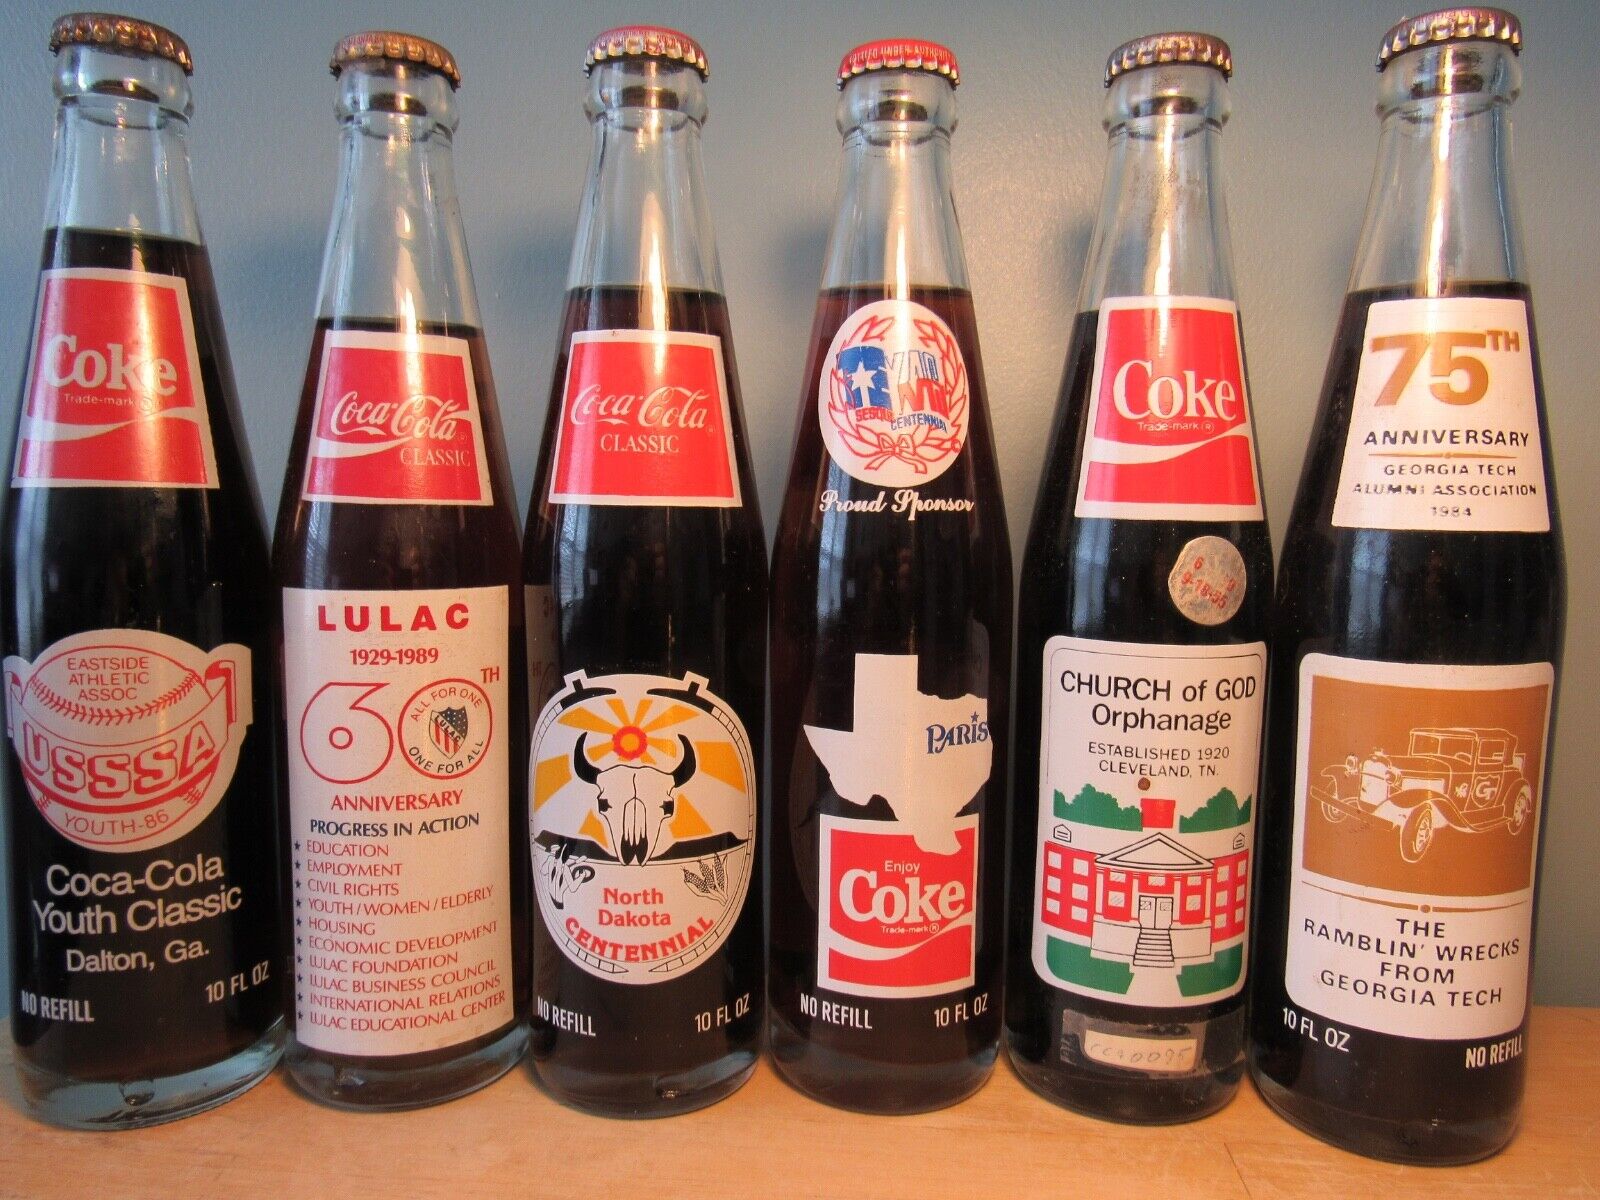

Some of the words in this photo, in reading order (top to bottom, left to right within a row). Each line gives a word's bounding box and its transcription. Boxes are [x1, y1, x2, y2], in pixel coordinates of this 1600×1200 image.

[43, 334, 178, 396] Coke
[570, 384, 709, 429] Coca-Cola
[1112, 360, 1237, 421] Coke
[331, 391, 460, 440] Coca-Cola
[600, 433, 680, 453] CLASSIC
[1364, 429, 1529, 447] ANNIVERSARY
[401, 448, 470, 466] CLASSIC
[1384, 464, 1469, 475] GEORGIA
[1478, 464, 1516, 476] TECH
[819, 489, 887, 513] Proud
[891, 489, 975, 521] Sponsor
[1353, 483, 1425, 495] ALUMNI
[1433, 484, 1537, 496] ASSOCIATION
[1430, 506, 1472, 517] 1984
[318, 603, 469, 632] LULAC
[67, 656, 150, 671] EASTSIDE
[350, 648, 439, 665] 1929-1989
[69, 672, 150, 686] ATHLETIC
[78, 687, 138, 701] ASSOC
[1060, 670, 1171, 701] CHURCH
[1182, 679, 1208, 701] of
[1215, 676, 1256, 701] GOD
[411, 700, 430, 722] ALL
[431, 687, 457, 701] FOR
[460, 688, 482, 708] ONE
[1092, 703, 1231, 735] Orphanage
[434, 715, 461, 743] LULAC
[926, 716, 990, 755] PARIS
[23, 720, 215, 799] USSSA
[409, 747, 433, 771] ONE
[437, 760, 463, 773] FOR
[467, 740, 483, 763] ALL
[1088, 741, 1190, 760] ESTABLISHED
[1198, 747, 1229, 760] 1920
[1099, 760, 1192, 778] CLEVELAND,
[1199, 765, 1219, 777] TN.
[331, 789, 463, 811] ANNIVERSARY
[65, 809, 169, 836] YOUTH-86
[310, 819, 388, 837] PROGRESS
[394, 823, 413, 835] IN
[418, 812, 479, 834] ACTION
[307, 840, 389, 857] EDUCATION
[46, 854, 224, 896] Coca-Cola
[307, 859, 402, 876] EMPLOYMENT
[884, 860, 920, 873] Enjoy
[308, 879, 339, 895] CIVIL
[344, 883, 400, 896] RIGHTS
[603, 888, 664, 905] North
[839, 868, 966, 924] Coke
[33, 900, 117, 934] Youth
[127, 884, 242, 931] Classic
[598, 909, 671, 927] Dakota
[309, 917, 375, 935] HOUSING
[309, 936, 390, 954] ECONOMIC
[396, 920, 498, 954] DEVELOPMENT
[565, 916, 714, 962] CENTENNIAL
[1304, 918, 1424, 958] RAMBLIN'
[1436, 939, 1519, 962] WRECKS
[1396, 918, 1445, 938] THE
[67, 949, 154, 972] Dalton,
[165, 940, 209, 964] Ga.
[310, 955, 347, 973] LULAC
[352, 952, 458, 974] FOUNDATION
[205, 981, 225, 1003] 10
[230, 973, 248, 996] FL
[252, 961, 270, 986] OZ
[310, 974, 347, 992] LULAC
[352, 977, 426, 993] BUSINESS
[431, 959, 497, 988] COUNCIL
[1320, 970, 1436, 1006] GEORGIA
[1448, 987, 1501, 1007] TECH
[1380, 962, 1454, 984] FROM
[21, 990, 36, 1016] NO
[41, 997, 94, 1022] REFILL
[310, 993, 423, 1013] INTERNATIONAL
[429, 975, 501, 1007] RELATIONS
[310, 1012, 347, 1030] LULAC
[351, 1009, 456, 1032] EDUCATIONAL
[461, 990, 505, 1017] CENTER
[537, 996, 549, 1021] NO
[552, 1004, 596, 1037] REFILL
[695, 1012, 711, 1033] 10
[717, 1002, 731, 1026] FL
[736, 993, 750, 1016] OZ
[800, 993, 817, 1017] NO
[822, 1001, 872, 1029] REFILL
[934, 1007, 949, 1028] 10
[955, 1002, 969, 1023] FL
[974, 993, 988, 1014] OZ
[1283, 1007, 1297, 1030] 10
[1300, 1017, 1318, 1042] FL
[1325, 1027, 1351, 1052] OZ
[1466, 1046, 1486, 1069] NO
[1490, 1034, 1522, 1065] REFILL
